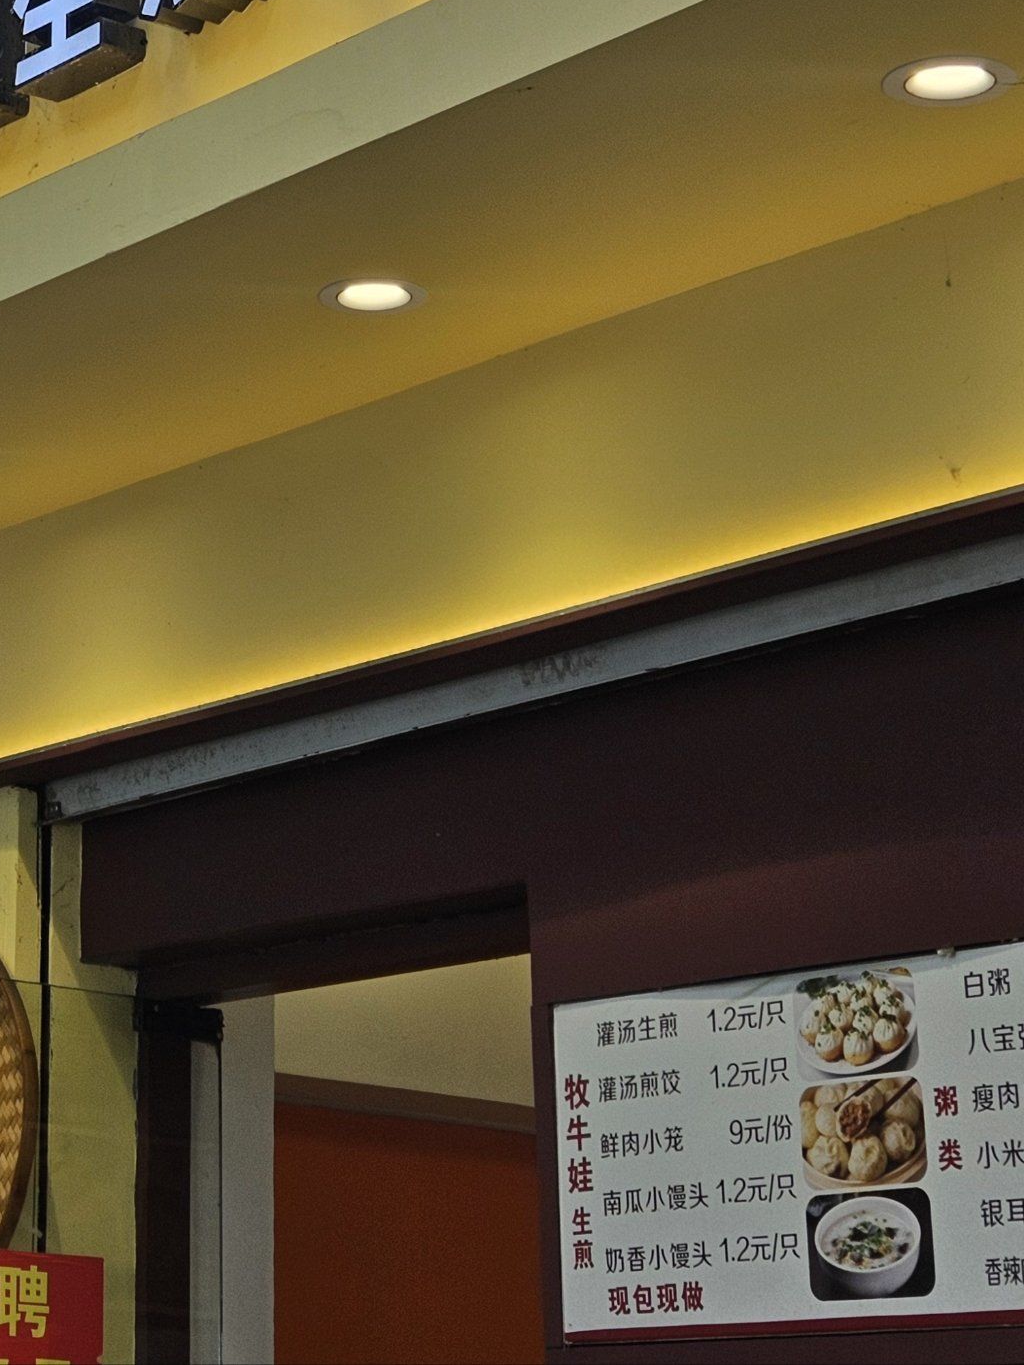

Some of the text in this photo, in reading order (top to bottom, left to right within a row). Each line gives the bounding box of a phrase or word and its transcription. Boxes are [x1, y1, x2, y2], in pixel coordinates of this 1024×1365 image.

[963, 968, 1011, 999] 白粥
[596, 1000, 786, 1047] 灌汤生煎 1.2元/只
[598, 1057, 790, 1103] 灌汤煎饺 1.2元/只
[972, 1081, 1020, 1113] 瘦肉
[600, 1114, 793, 1159] 鲜肉小笼 9元/份
[933, 1085, 963, 1172] 粥类
[976, 1138, 1024, 1170] 小米
[603, 1173, 797, 1216] 南瓜小馒头 1.2元/只
[980, 1197, 1024, 1229] 银耳
[605, 1233, 800, 1274] 奶香小馒头 1.2元/只
[985, 1256, 1024, 1286] 香辣
[608, 1281, 704, 1315] 现包现做
